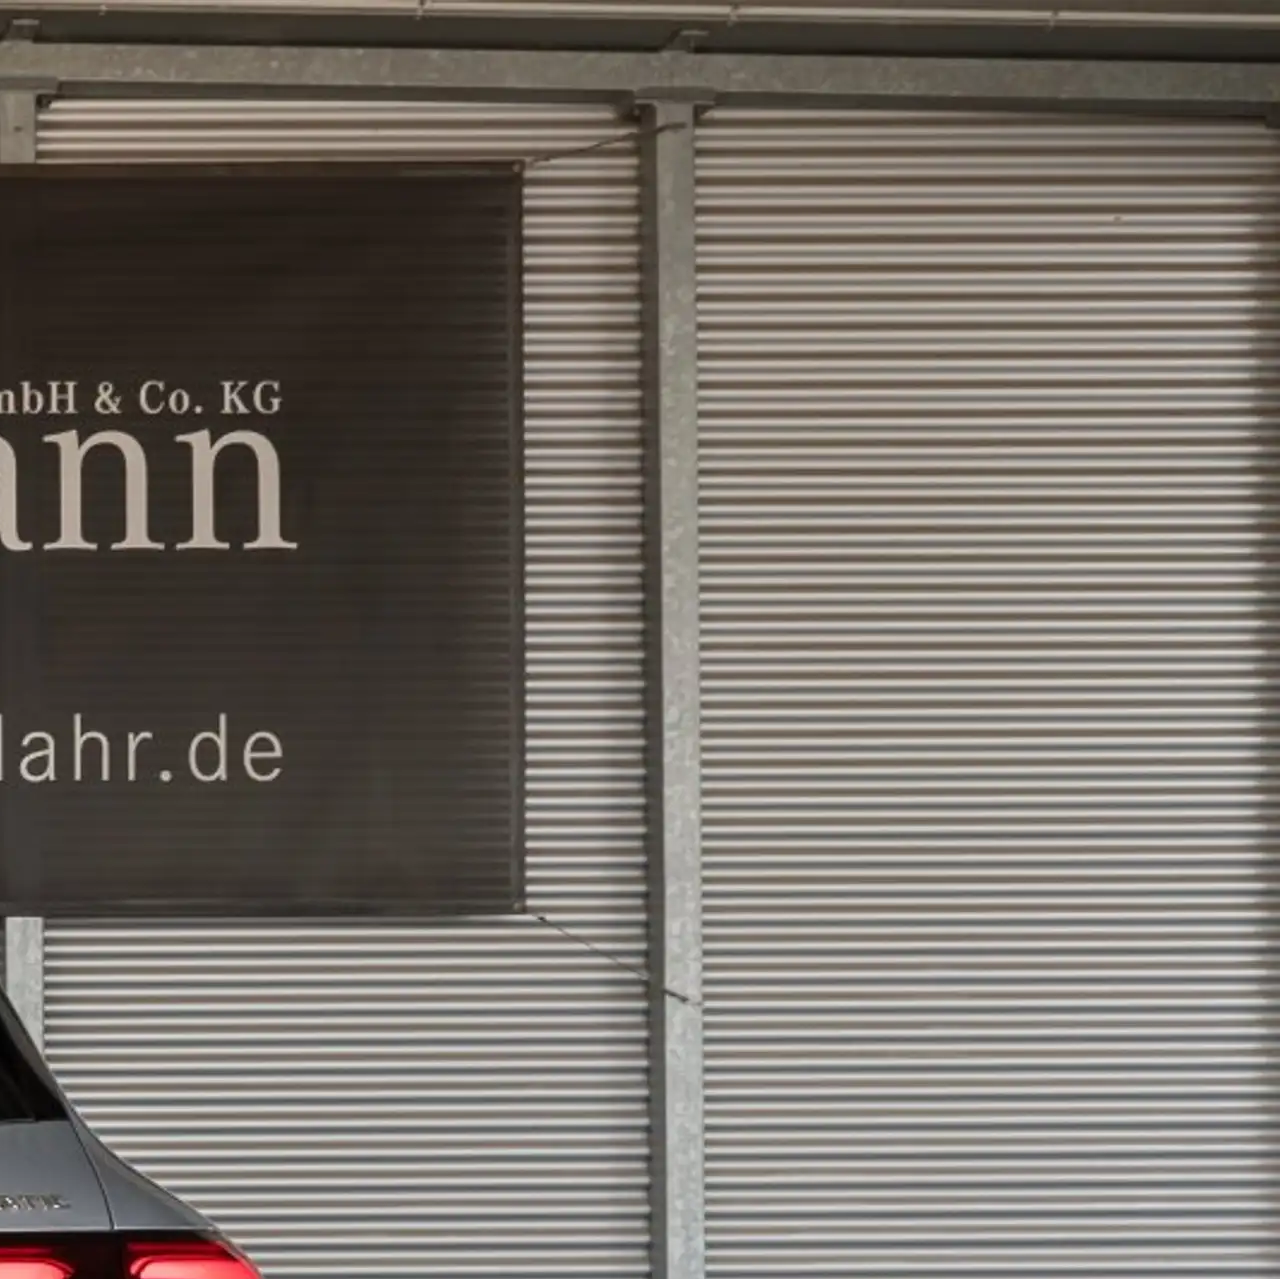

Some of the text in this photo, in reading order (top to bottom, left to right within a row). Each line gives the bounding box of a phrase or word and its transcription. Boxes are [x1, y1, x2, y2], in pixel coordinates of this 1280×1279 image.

[94, 381, 122, 414] &
[139, 380, 203, 414] Co.
[221, 381, 282, 414] KG
